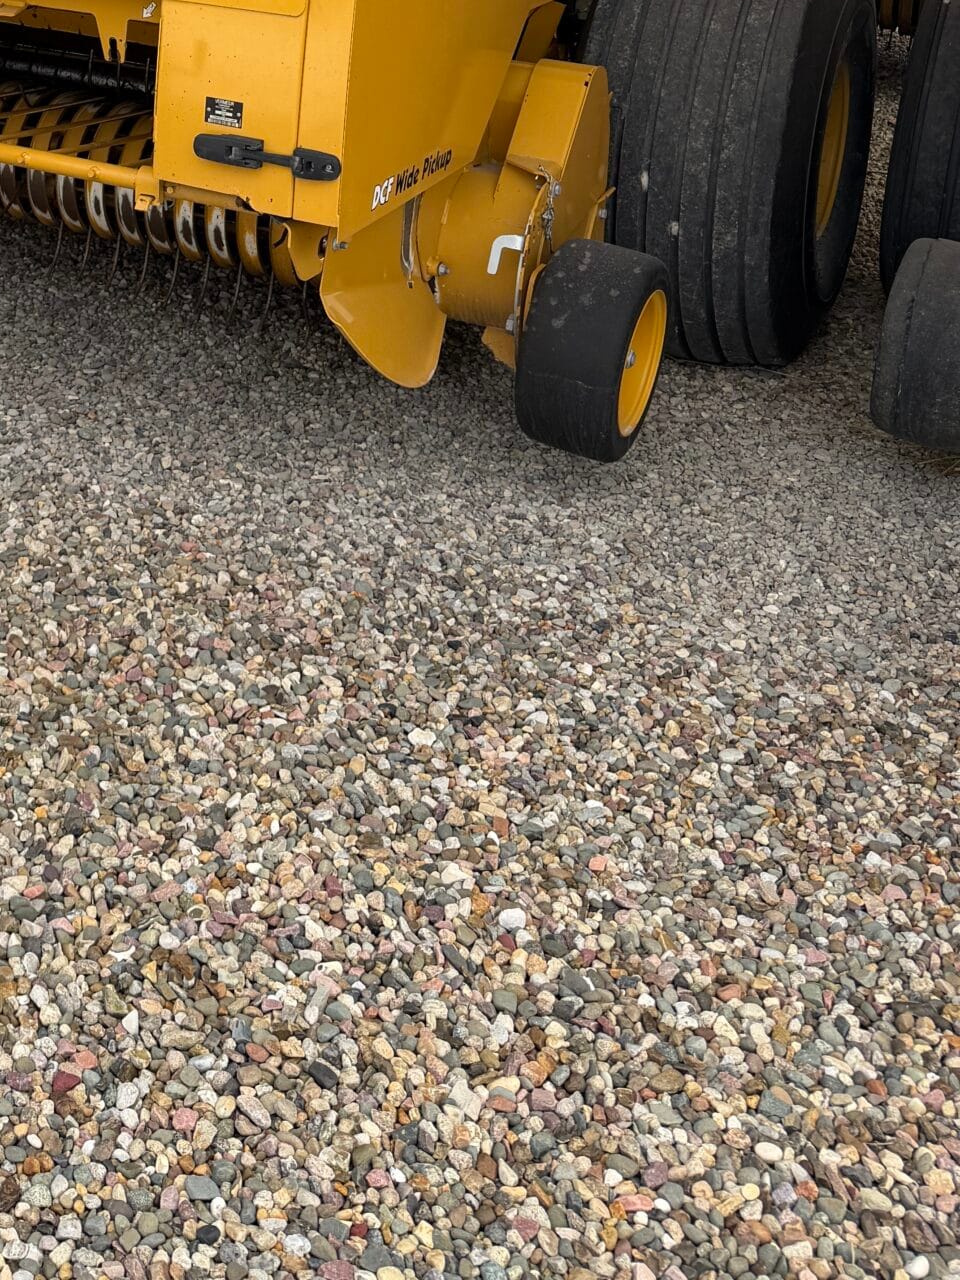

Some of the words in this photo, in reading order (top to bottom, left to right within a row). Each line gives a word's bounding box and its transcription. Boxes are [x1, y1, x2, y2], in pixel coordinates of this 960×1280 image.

[371, 175, 395, 211] DCF
[395, 165, 420, 196] Wide
[421, 149, 452, 180] Pickup
